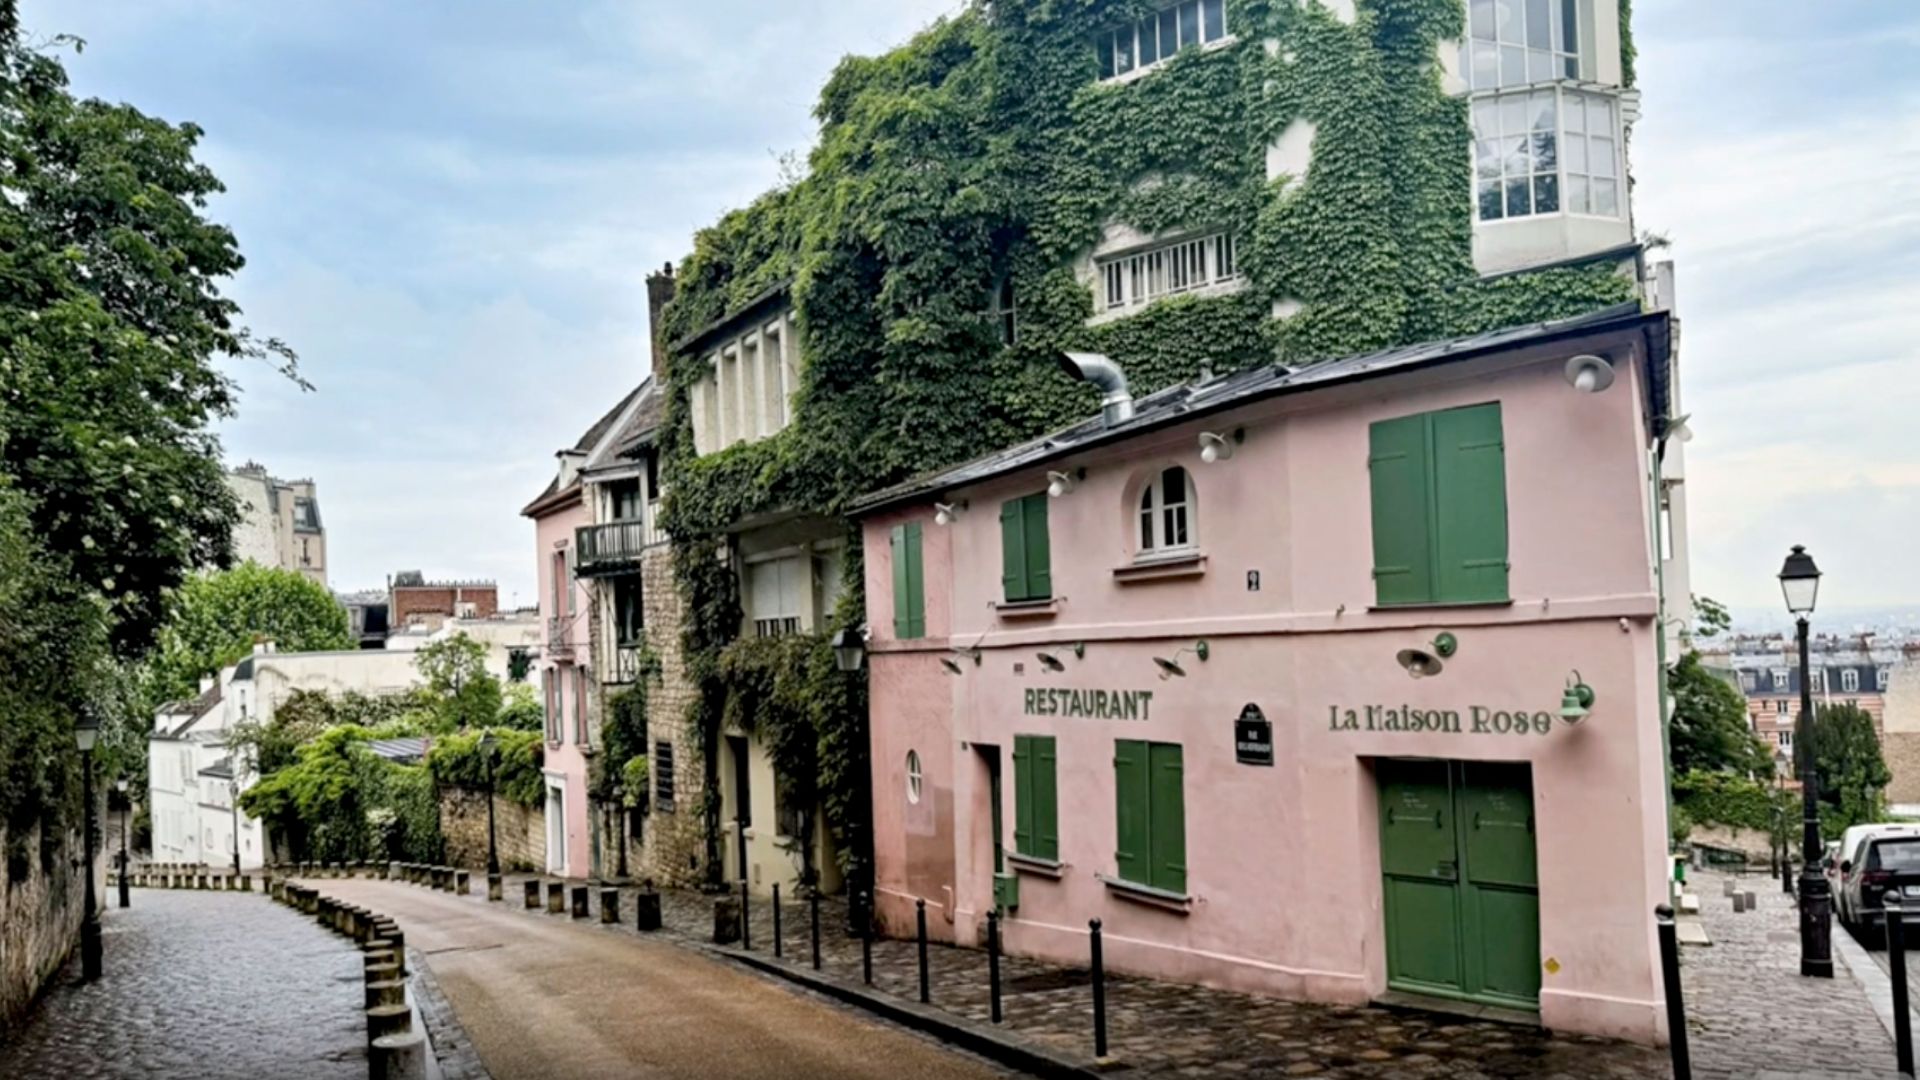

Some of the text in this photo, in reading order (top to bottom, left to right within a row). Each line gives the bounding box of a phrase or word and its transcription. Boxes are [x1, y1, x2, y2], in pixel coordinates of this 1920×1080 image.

[1024, 688, 1153, 720] RESTAURANT
[1329, 704, 1552, 735] La Maison Rose
